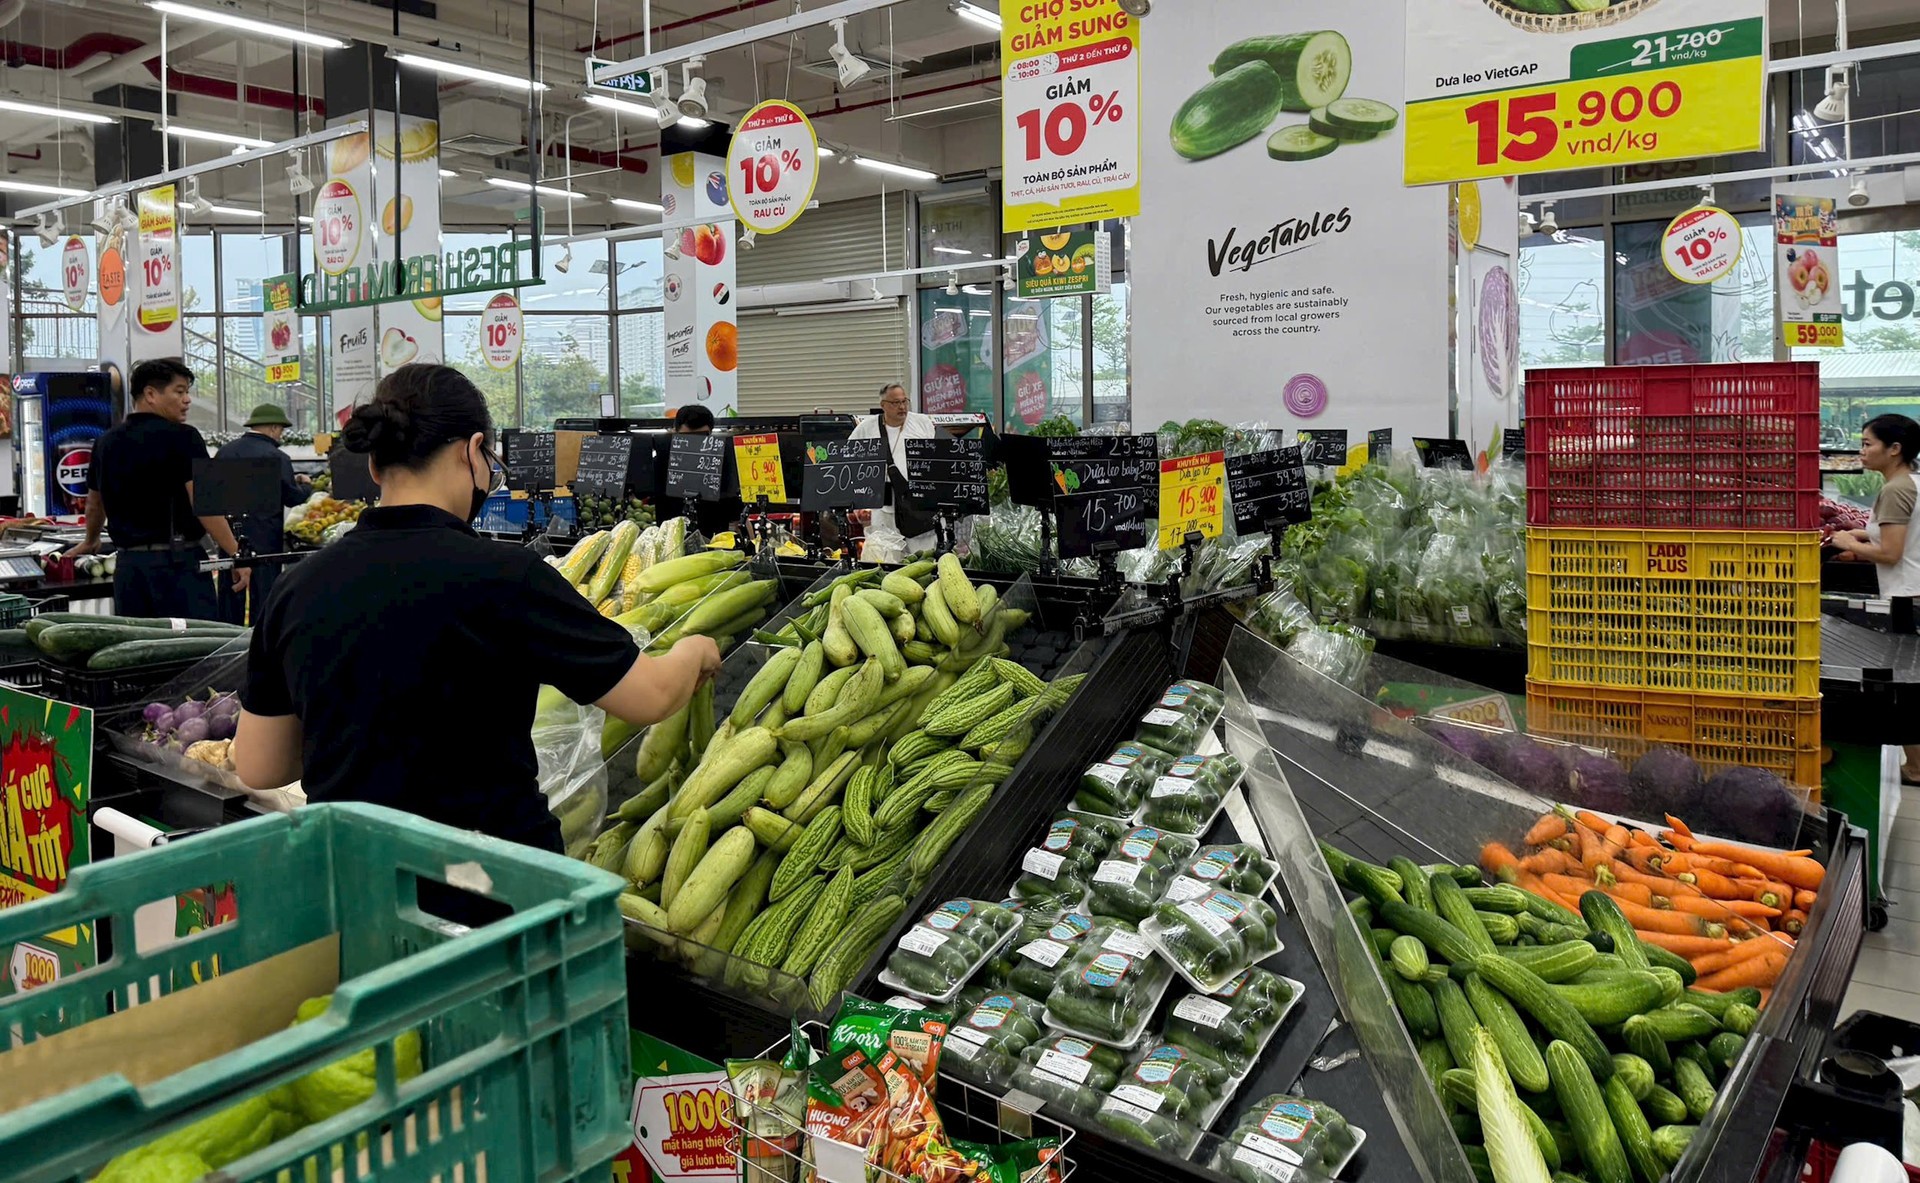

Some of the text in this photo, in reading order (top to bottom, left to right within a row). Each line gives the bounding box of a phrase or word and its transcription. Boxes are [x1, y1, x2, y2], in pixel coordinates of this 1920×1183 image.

[1011, 12, 1128, 52] GIẢM SUNG
[1062, 54, 1078, 64] THỨ
[1086, 48, 1102, 59] ĐẾN
[1104, 45, 1121, 55] THỨ
[1630, 28, 1722, 67] 21.700
[1671, 48, 1707, 61] vnd/kg
[1016, 60, 1040, 70] 08:00
[1018, 69, 1040, 78] 10:00
[1435, 62, 1539, 88] Dưa leo VietGAP
[1046, 76, 1091, 100] GIẢM
[1017, 90, 1123, 161] 10%
[1464, 80, 1682, 166] 15.900
[755, 135, 781, 152] GIẢM
[1567, 128, 1658, 156] vnd/kg
[740, 148, 802, 195] 10%
[1023, 158, 1117, 184] TOÀN BỘ SẢN PHẨM
[328, 204, 342, 215] GIẢM
[754, 203, 786, 218] RAU CỦ
[320, 214, 353, 246] 10%
[1683, 227, 1706, 242] GIẢM
[1674, 227, 1727, 267] 10%
[66, 263, 84, 288] 10%
[143, 255, 171, 287] 10%
[1696, 259, 1728, 277] TRÁI CÂY
[102, 272, 121, 284] TASTE
[1053, 277, 1067, 286] KIWI
[1068, 275, 1089, 284] ZESPRI
[1220, 285, 1334, 302] Fresh, hygienic and safe.
[1205, 297, 1349, 315] Our vegetables are sustainably
[495, 312, 508, 322] GIẢM
[1212, 311, 1340, 326] sourced from local growers
[487, 322, 517, 347] 10%
[1232, 324, 1321, 337] across the country.
[1797, 324, 1838, 344] 59.000
[945, 373, 960, 386] XE
[1109, 436, 1154, 456] 25.900
[1083, 459, 1140, 483] Dưa leo baby
[1177, 455, 1211, 468] KHUYẾN MÃI
[60, 468, 89, 478] PEP
[816, 464, 880, 495] 30.600
[1178, 485, 1217, 517] 15.900
[1082, 494, 1137, 532] 15.700
[1648, 544, 1686, 558] LADO
[1648, 559, 1688, 573] PLUS
[21, 763, 52, 817] CỰC
[28, 814, 67, 881] TỐT
[833, 1023, 882, 1049] Knorr
[809, 1109, 850, 1126] HƯƠNG
[663, 1139, 680, 1155] mặt
[682, 1136, 703, 1151] hàng
[681, 1152, 736, 1168] giá luôn thấp
